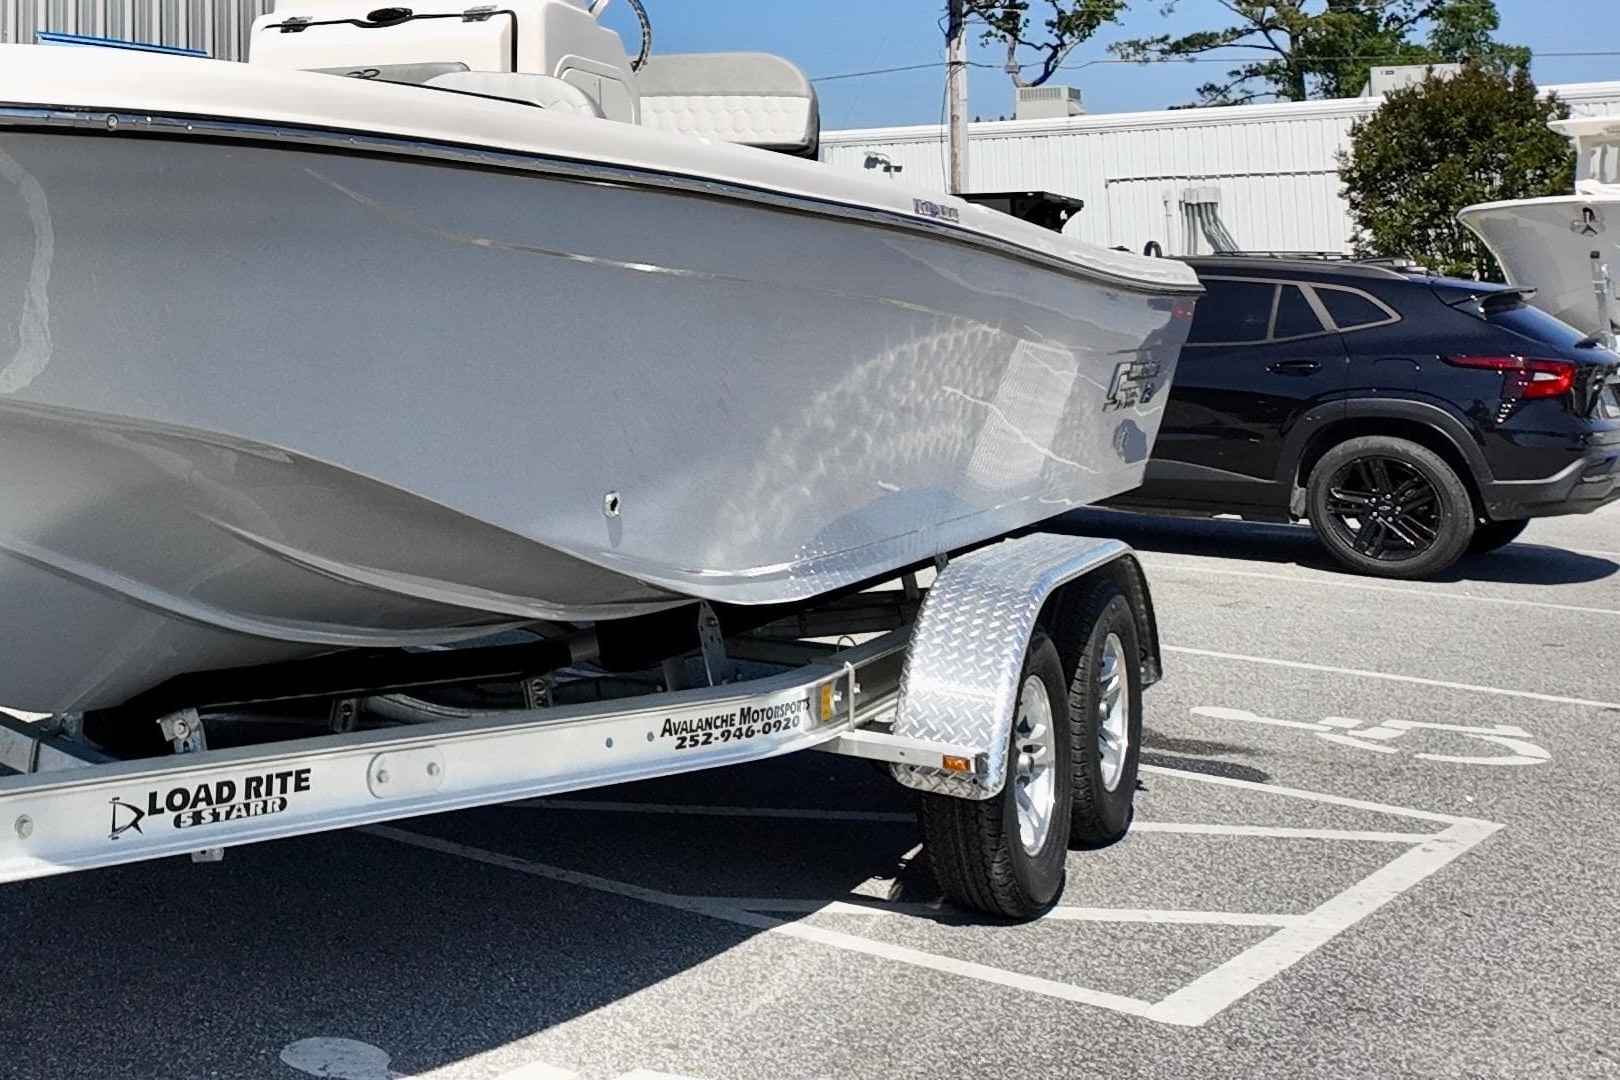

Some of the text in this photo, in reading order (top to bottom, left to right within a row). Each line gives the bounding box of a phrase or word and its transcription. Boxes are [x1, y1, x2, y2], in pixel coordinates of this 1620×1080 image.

[660, 713, 736, 738] AVALANCHE
[675, 715, 800, 750] 252-946-0920
[148, 768, 311, 816] LOAD RITE
[180, 798, 282, 828] 5 STARR
